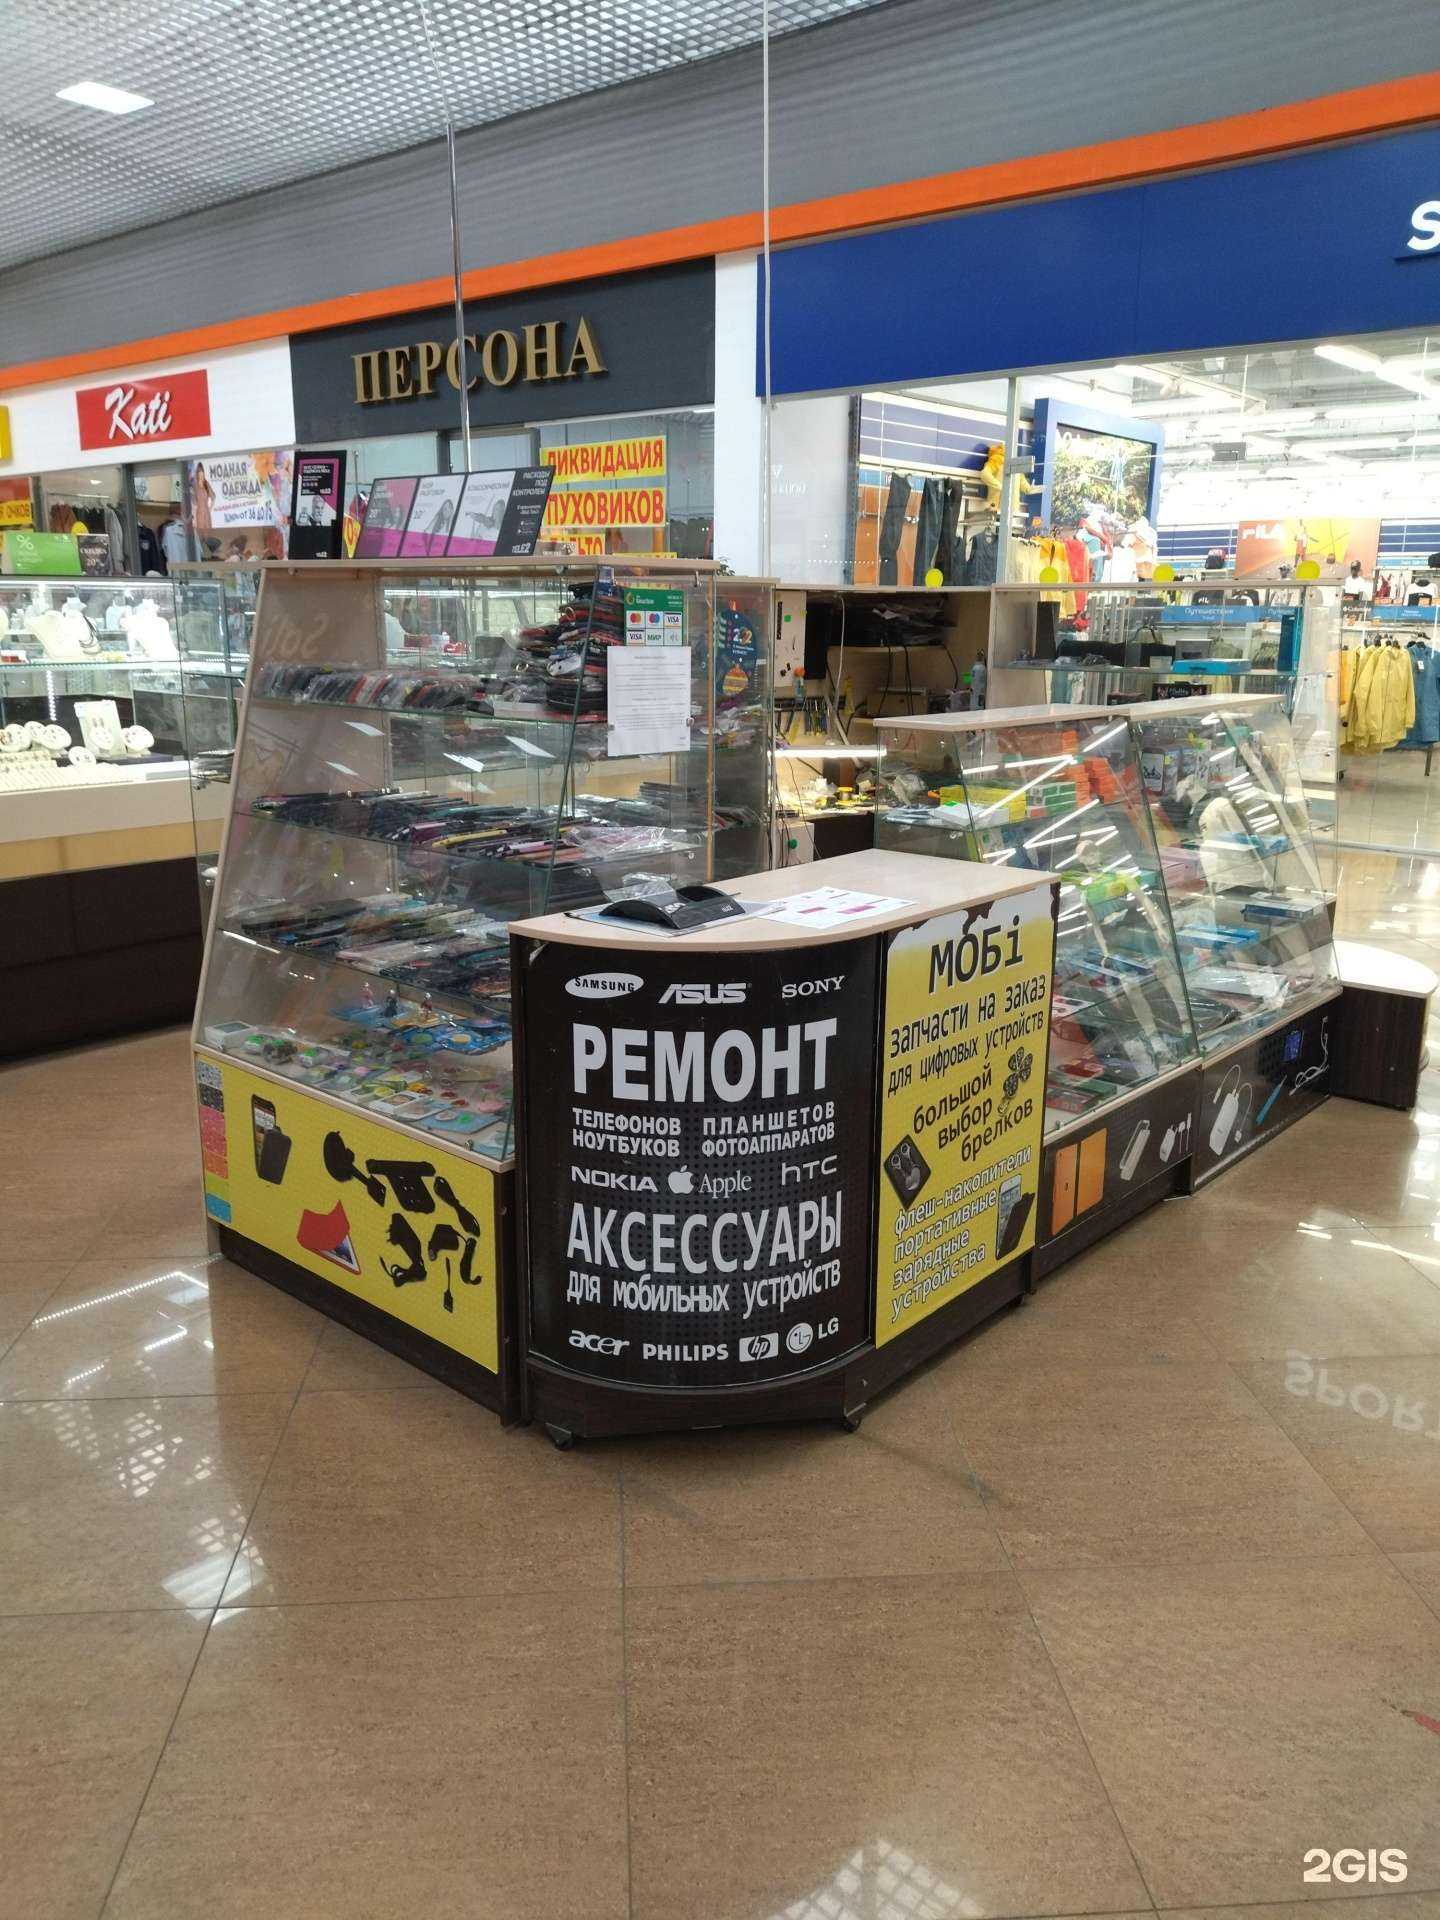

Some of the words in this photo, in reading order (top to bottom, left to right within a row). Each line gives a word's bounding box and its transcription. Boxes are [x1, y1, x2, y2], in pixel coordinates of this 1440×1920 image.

[352, 315, 608, 404] ПЕРСОНА
[105, 386, 173, 440] Kati
[209, 462, 248, 479] МОДНАЯ
[547, 439, 663, 477] ЛИКВИДАЦИЯ
[222, 480, 261, 496] ОДЕЖДА
[547, 489, 664, 526] ПУХОВИКОВ
[629, 632, 643, 641] VISA
[667, 615, 680, 624] VISA
[574, 976, 635, 993] SAMSUNG
[658, 982, 747, 1005] ASUS
[781, 975, 845, 999] SONY
[978, 992, 996, 1023] на
[1004, 974, 1046, 1013] заказ
[572, 1017, 838, 1103] РЕМОНТ
[887, 1063, 912, 1098] для
[920, 1036, 979, 1082] цифровых
[985, 1010, 1044, 1059] устройств
[572, 1106, 681, 1136] ТЕЛЕФОНОВ
[703, 1101, 835, 1136] ПЛАНШЕТОВ
[913, 1062, 992, 1134] большой
[938, 1098, 992, 1150] выбор
[572, 1129, 680, 1158] НОУТБУКОВ
[701, 1121, 835, 1158] ФОТОАППАРАТОВ
[961, 1098, 1033, 1162] брелков
[571, 1165, 658, 1193] NOKIA
[699, 1169, 752, 1199] Apple
[895, 1145, 1032, 1240] флеш-накопители
[567, 1190, 842, 1274] АКСЕССУАРЫ
[894, 1188, 997, 1264] портативные
[891, 1243, 986, 1323] устройства
[892, 1229, 970, 1290] зарядные
[567, 1271, 600, 1305] для
[613, 1273, 730, 1313] мобильных
[742, 1259, 841, 1319] устройств
[568, 1329, 630, 1357] acer
[642, 1343, 729, 1362] PHILIPS
[818, 1317, 839, 1340] LG
